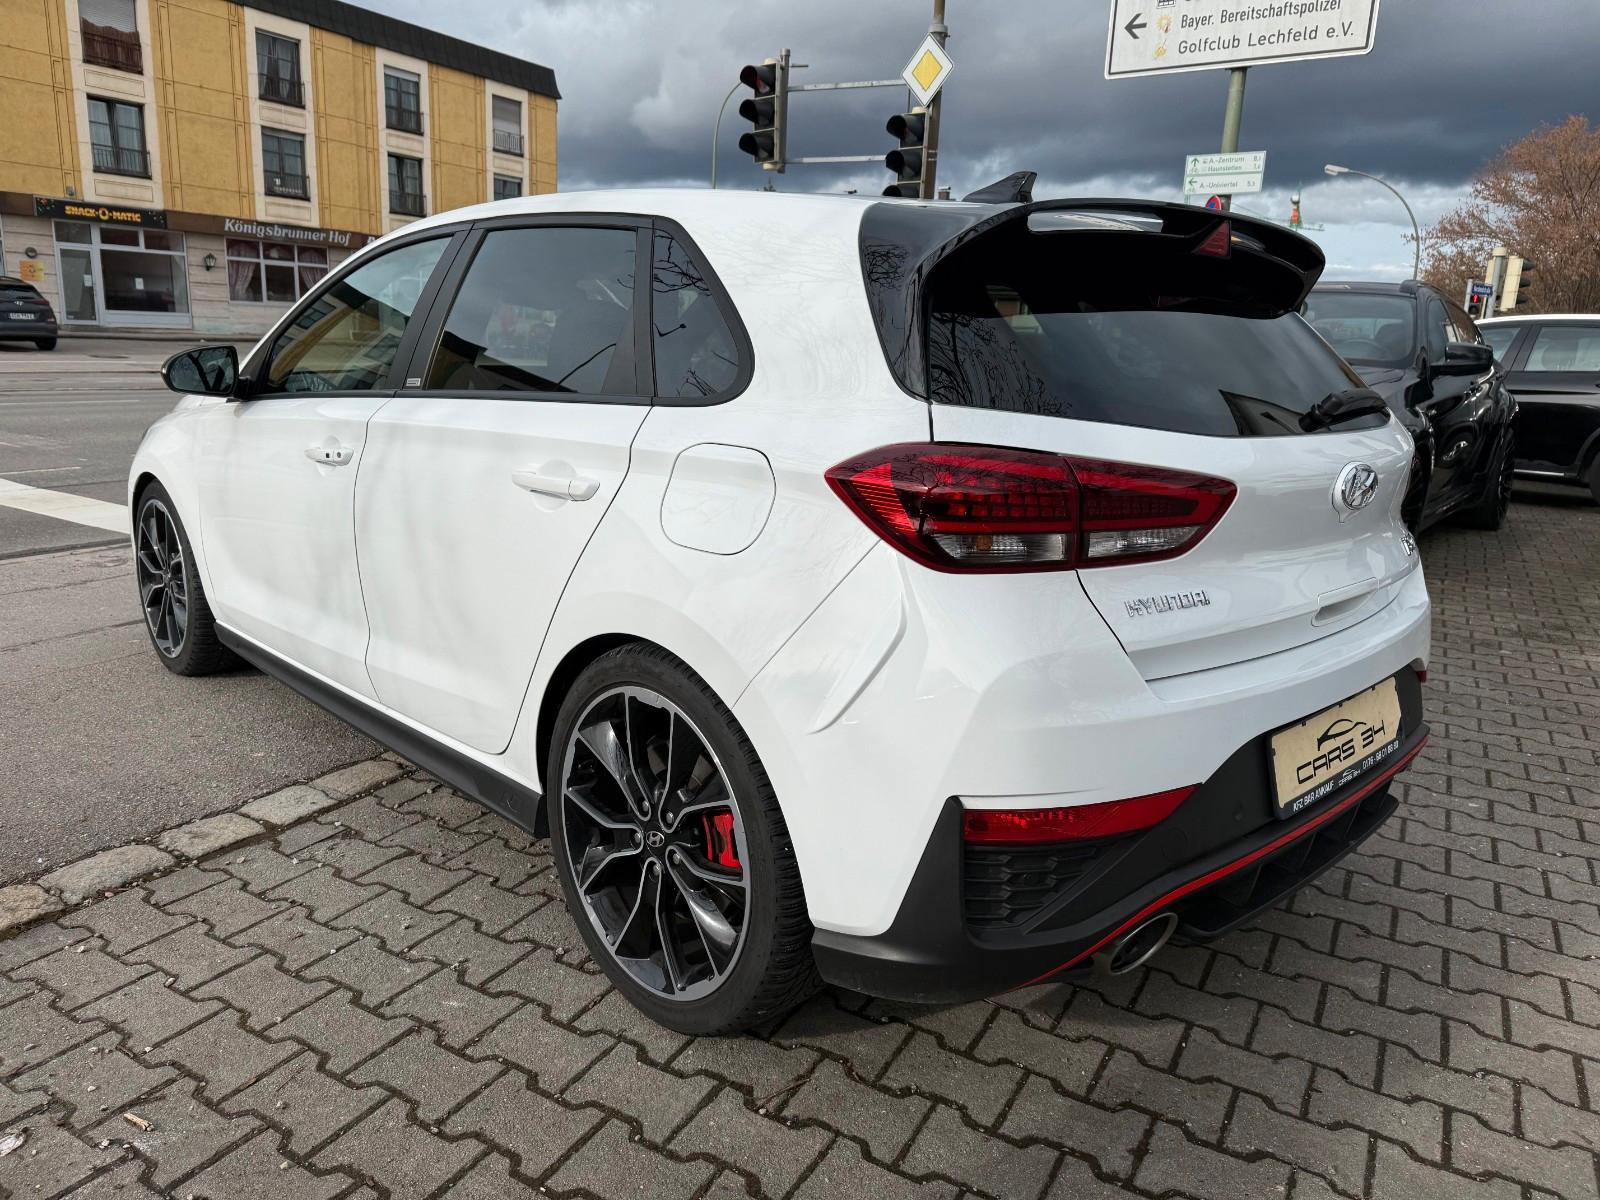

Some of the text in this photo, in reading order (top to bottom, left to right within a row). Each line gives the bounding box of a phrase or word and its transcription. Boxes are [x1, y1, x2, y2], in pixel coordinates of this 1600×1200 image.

[1180, 0, 1342, 31] Bayer. Bereitschaftspolizei
[1178, 21, 1354, 54] Golfclub Lechfeld e.V.
[223, 218, 327, 241] Königsbrunner
[329, 231, 352, 247] Hof
[1124, 589, 1211, 618] HYUNDAI
[1296, 719, 1386, 785] CARS 34
